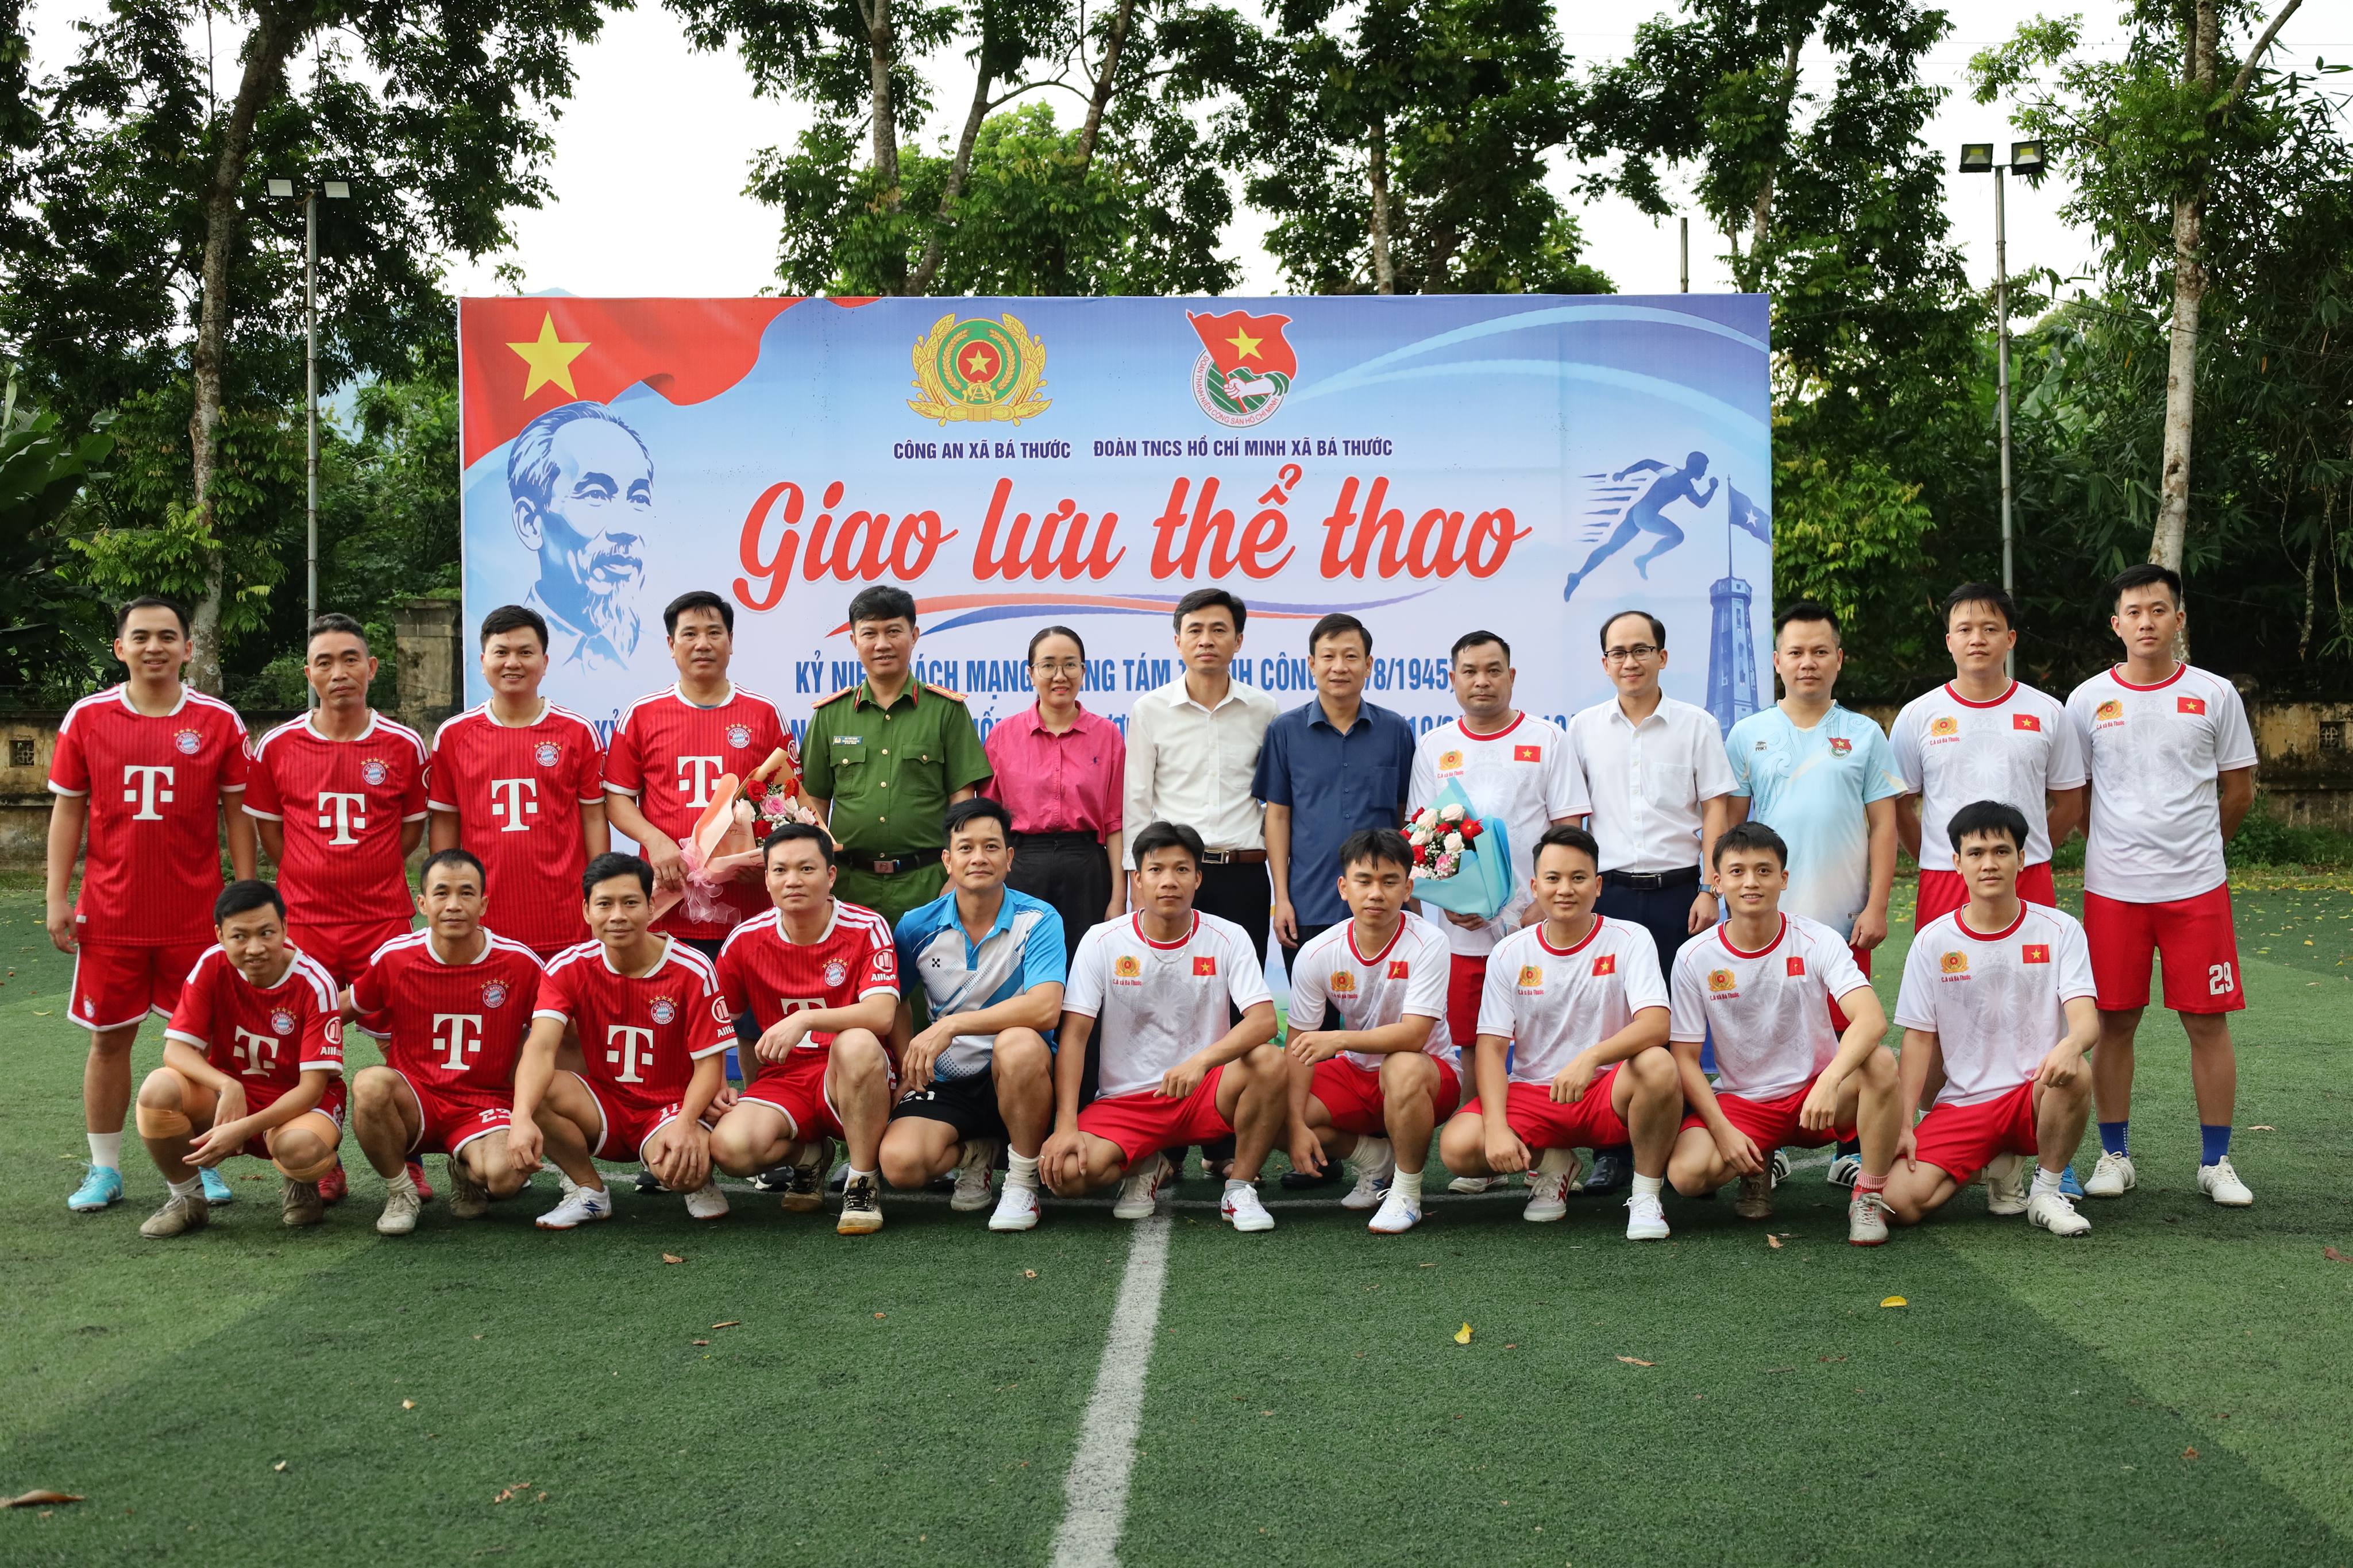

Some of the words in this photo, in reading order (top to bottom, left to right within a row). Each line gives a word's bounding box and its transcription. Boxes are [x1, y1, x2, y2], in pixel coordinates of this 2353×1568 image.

[1265, 397, 1279, 414] MINH
[894, 439, 936, 459] CÔNG
[942, 443, 963, 459] AN
[969, 439, 990, 458] XÃ
[995, 439, 1016, 458] BÁ
[1020, 439, 1071, 458] THƯỚC
[1093, 437, 1136, 457] ĐOÀN
[1141, 441, 1182, 457] TNCS
[1188, 435, 1208, 456] HỒ
[1214, 437, 1239, 457] CHÍ
[1245, 440, 1286, 456] MINH
[1291, 437, 1311, 456] XÃ
[1317, 437, 1337, 456] BÁ
[1343, 437, 1392, 456] THƯỚC
[732, 481, 959, 611] Giao
[973, 478, 1126, 580] lưu
[1150, 464, 1302, 580] thể
[1321, 476, 1532, 579] thao
[796, 650, 824, 693] KỶ
[909, 654, 958, 693] ÁCH
[1123, 652, 1170, 692] TÁM
[124, 765, 173, 820] T
[491, 778, 538, 832] T
[677, 755, 723, 808] T
[318, 792, 365, 845] T
[2209, 961, 2234, 995] 29
[233, 1025, 279, 1077] T
[433, 1014, 482, 1071] T
[607, 1025, 654, 1083] T
